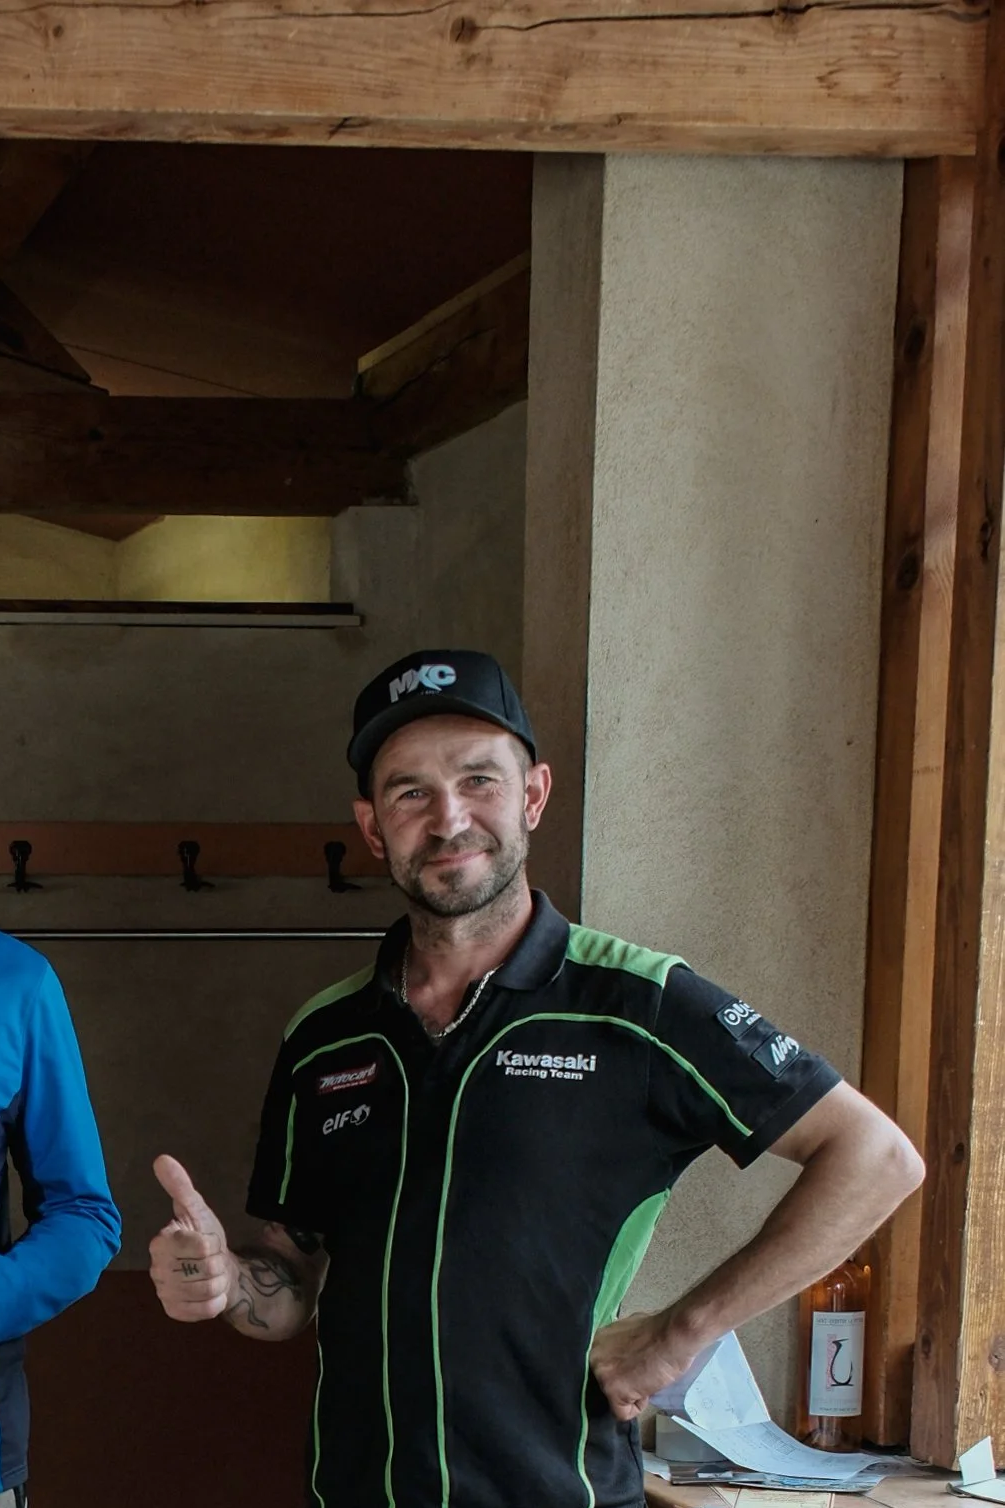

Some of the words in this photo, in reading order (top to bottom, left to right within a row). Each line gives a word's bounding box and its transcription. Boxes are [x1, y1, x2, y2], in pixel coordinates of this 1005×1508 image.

[496, 1050, 597, 1072] Kawasaki
[505, 1067, 547, 1079] Racing
[550, 1069, 583, 1080] Team
[322, 1110, 351, 1135] elf
